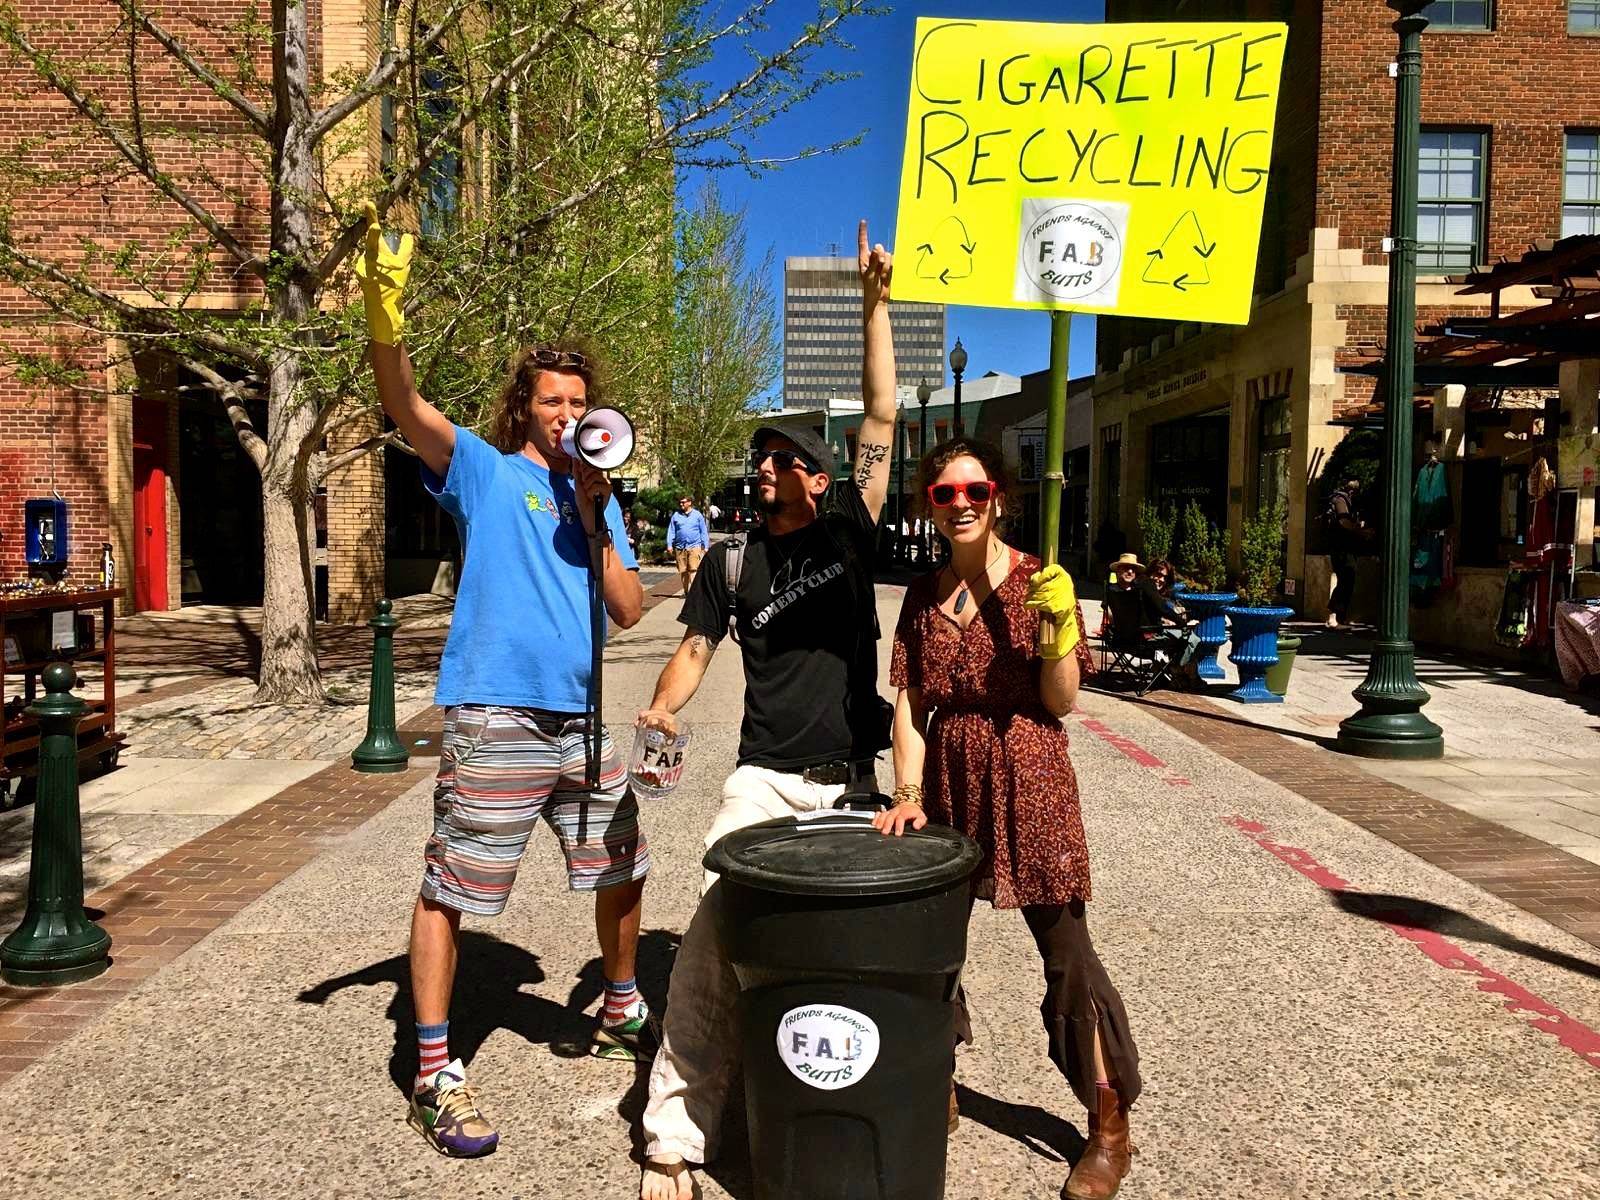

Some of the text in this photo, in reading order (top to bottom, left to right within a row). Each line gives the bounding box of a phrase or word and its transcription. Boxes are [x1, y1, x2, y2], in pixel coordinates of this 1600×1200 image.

[915, 22, 1282, 106] CIGARETTE
[916, 110, 1269, 204] RECYCLING
[1031, 214, 1115, 241] FRIENDS AGAINST
[1040, 269, 1093, 288] BUTTS
[751, 562, 845, 630] COMEDY CLUB
[643, 745, 683, 768] FAB
[784, 1009, 872, 1034] FRIENDS AGAINST
[795, 1062, 854, 1083] BUTTS
